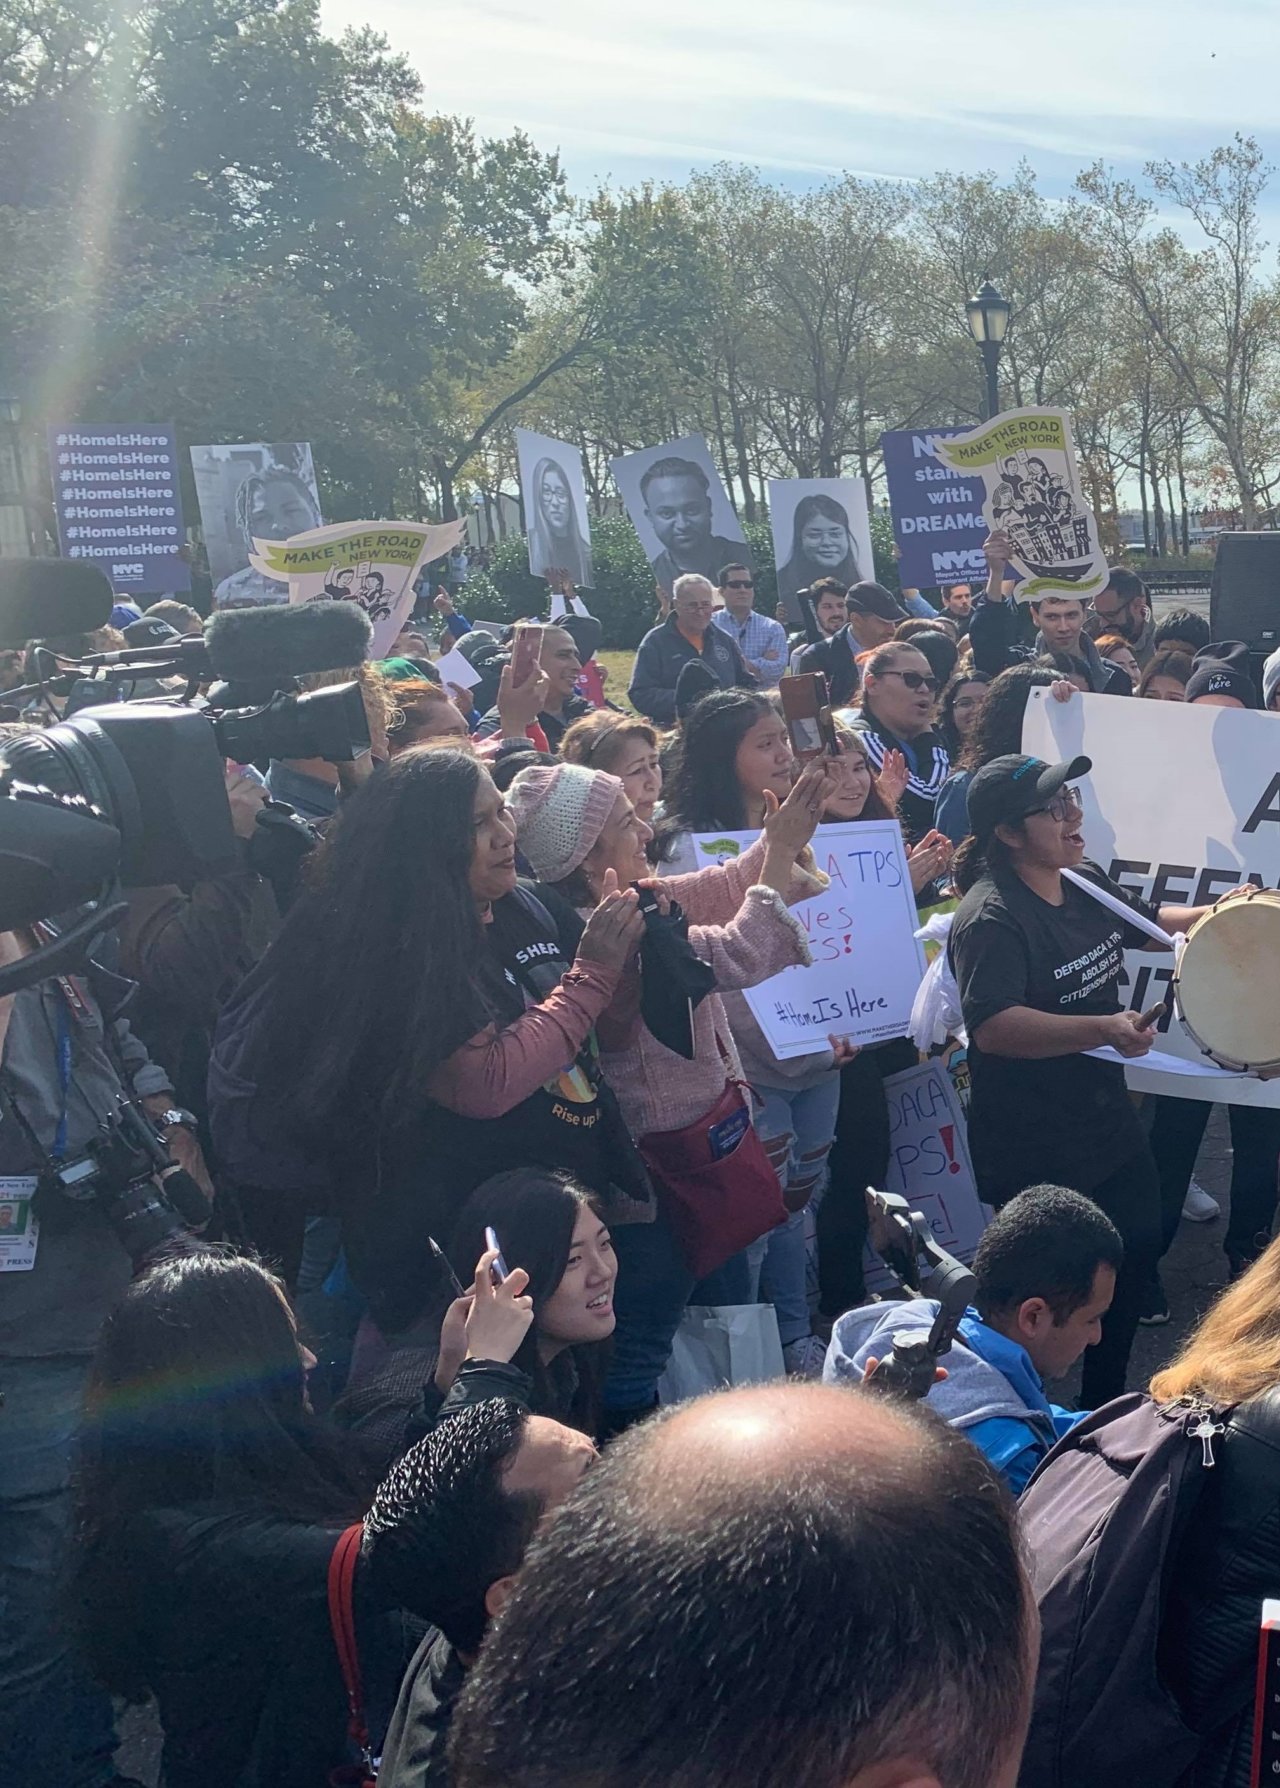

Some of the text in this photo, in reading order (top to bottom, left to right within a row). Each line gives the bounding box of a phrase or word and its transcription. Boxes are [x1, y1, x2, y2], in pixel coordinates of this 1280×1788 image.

[56, 433, 168, 446] #HomeIsHere
[959, 420, 1060, 459] MAKE THE ROAD
[1005, 435, 1060, 450] NEW YORK
[57, 452, 170, 464] #HomeIsHere
[59, 468, 172, 481] #HomeIsHere
[915, 466, 981, 481] stan
[62, 487, 173, 500] #HomeIsHere
[927, 487, 973, 504] with
[64, 505, 175, 518] #HomeIsHere
[66, 525, 178, 538] #HomeIsHere
[901, 513, 987, 534] DREAMe
[68, 543, 179, 557] #HomeIsHere
[283, 535, 421, 564] MAKE THE ROAD
[349, 549, 416, 562] NEW YORK
[932, 549, 987, 571] NYC
[1209, 679, 1231, 691] here
[848, 851, 901, 887] TPS
[1054, 931, 1122, 980] DEFEND DACA & TPS
[1081, 957, 1110, 984] ABOLISH
[1108, 950, 1119, 965] ICE
[1060, 972, 1108, 1004] CITIZENSHIP
[552, 1103, 580, 1126] Rise
[891, 1125, 960, 1189] PS!
